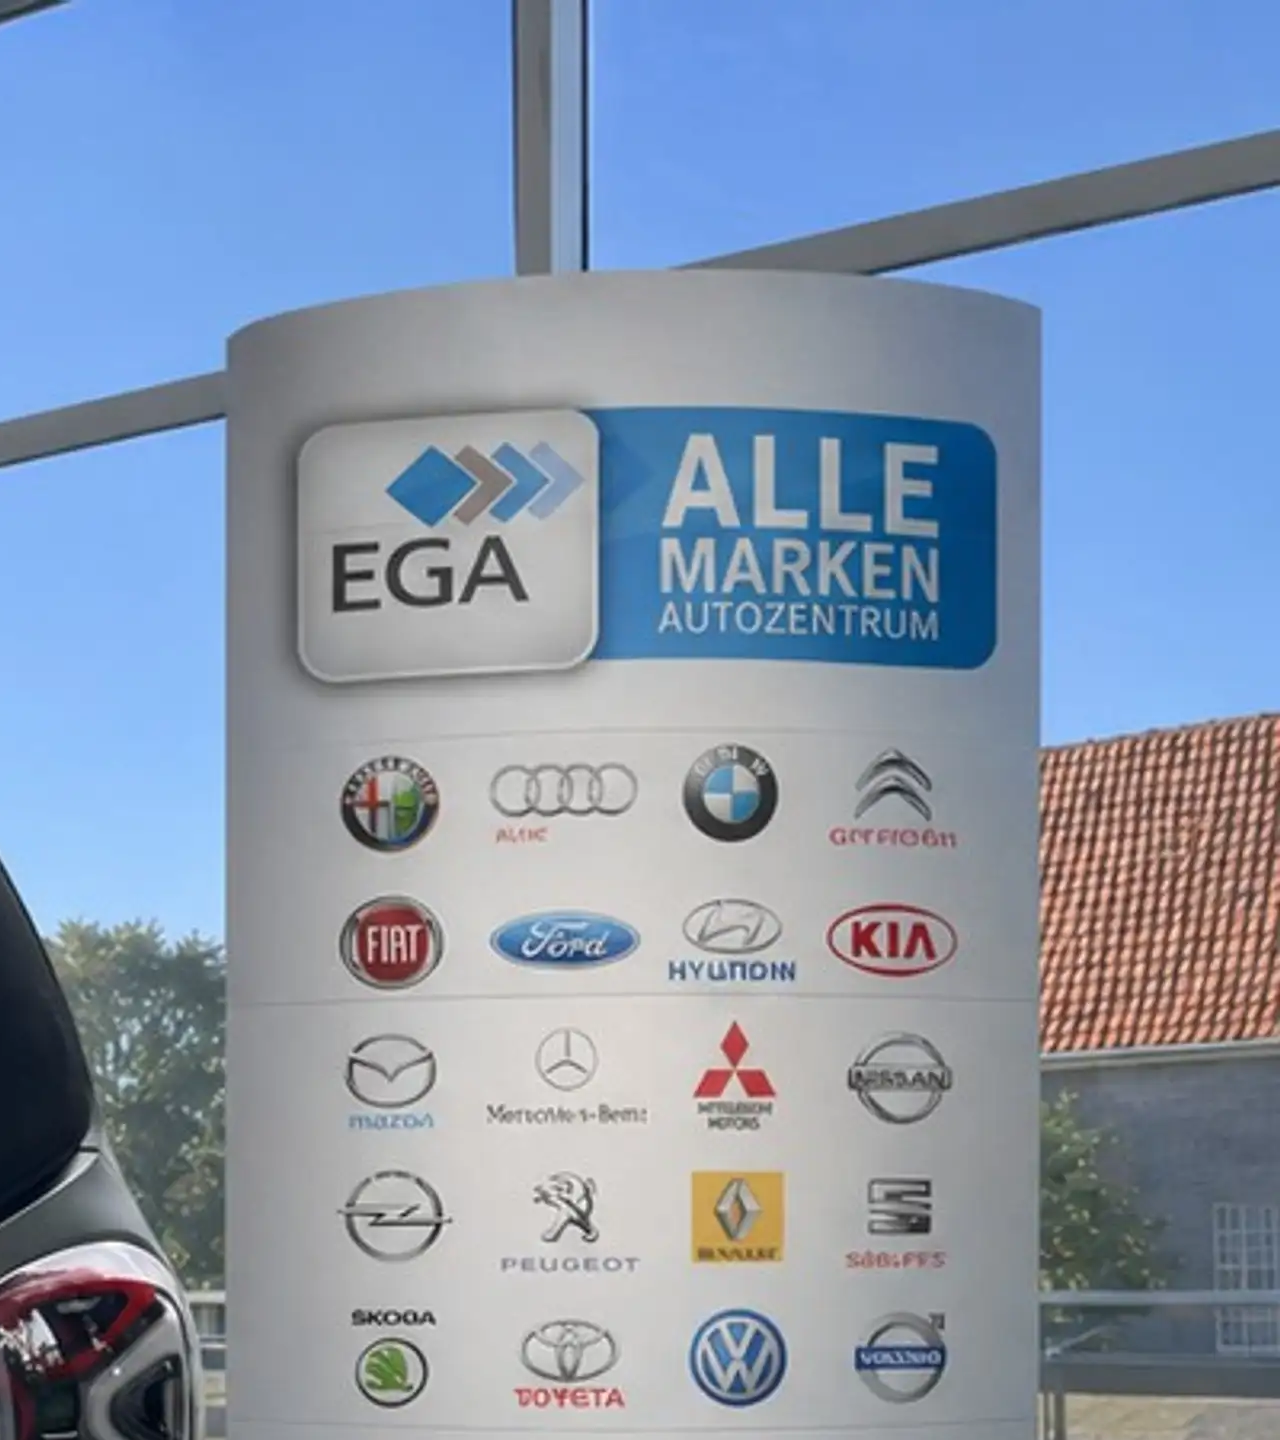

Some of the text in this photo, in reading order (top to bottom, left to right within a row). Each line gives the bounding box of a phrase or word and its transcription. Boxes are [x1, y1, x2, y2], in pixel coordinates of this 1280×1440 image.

[661, 433, 939, 538] ALLE
[331, 535, 529, 613] EGA
[659, 538, 939, 603] MARKEN
[657, 600, 939, 641] AUTOZENTRUM
[366, 924, 425, 964] FIAT
[521, 921, 611, 957] Ford
[850, 920, 938, 960] KIA
[500, 1256, 640, 1273] PEUGEOT
